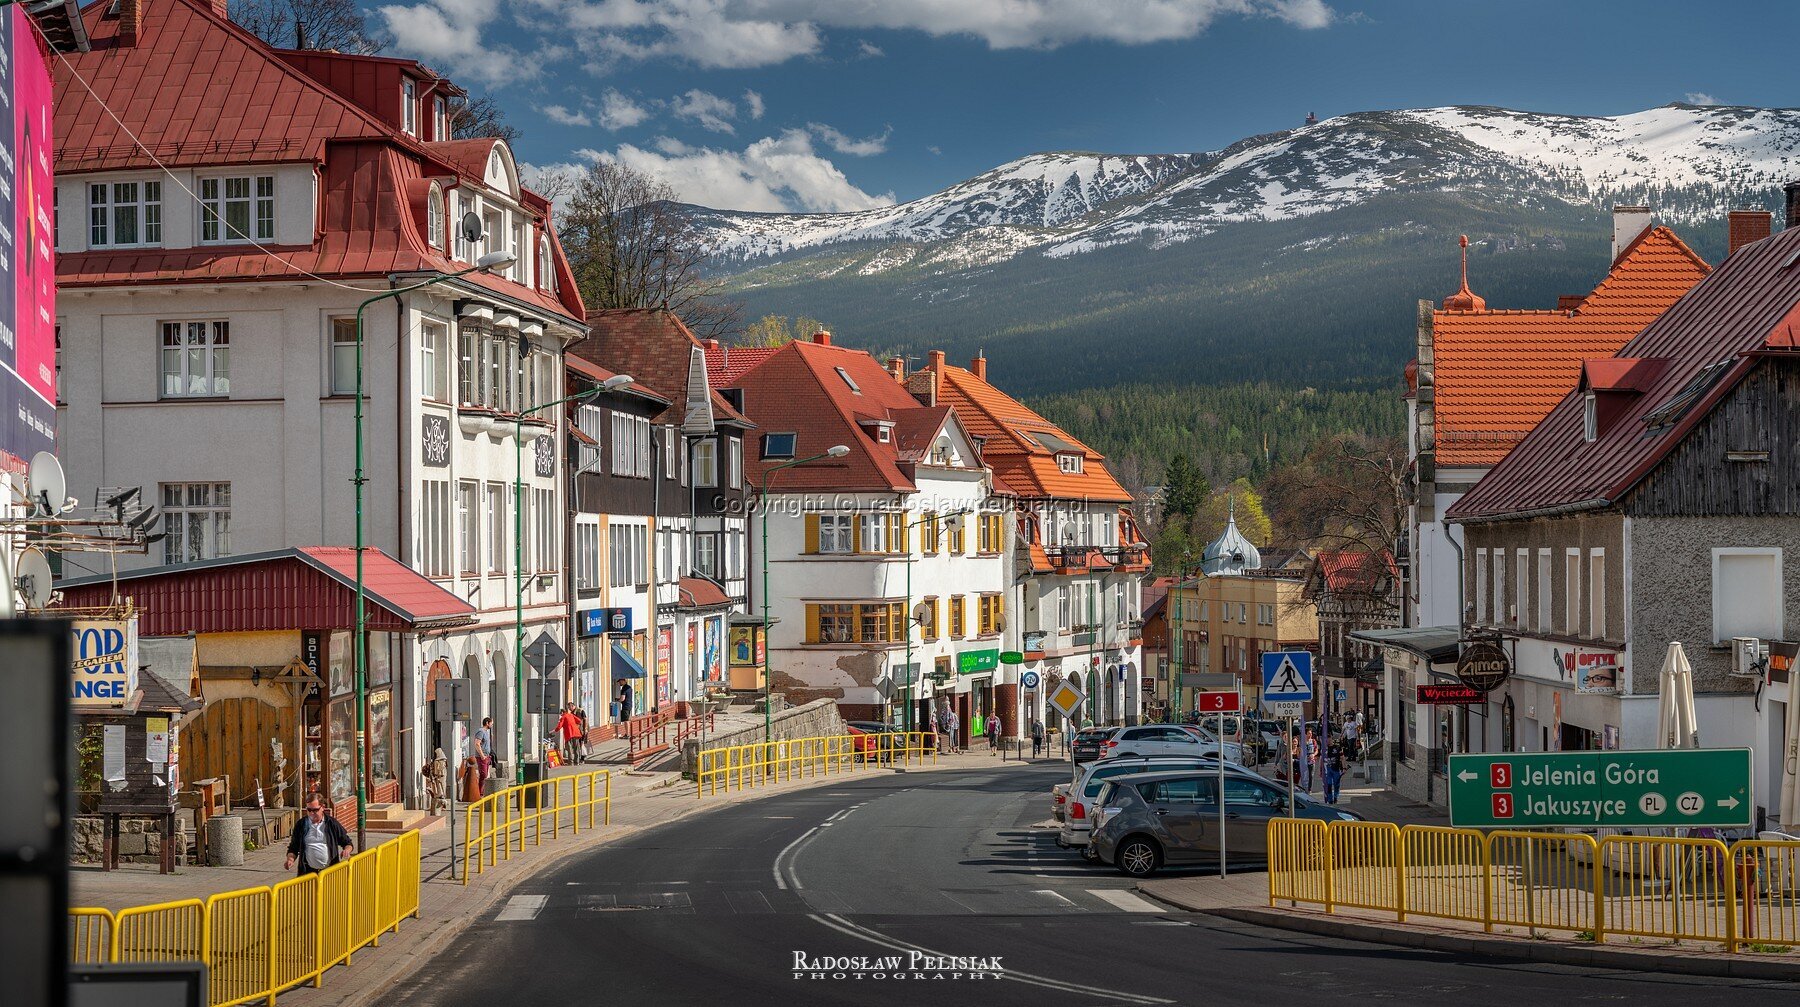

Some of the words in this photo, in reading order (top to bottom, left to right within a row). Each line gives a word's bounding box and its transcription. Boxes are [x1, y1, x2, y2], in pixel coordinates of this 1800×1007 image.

[72, 628, 124, 675] OR
[1579, 653, 1616, 667] OPTYK
[72, 680, 126, 698] NGE
[1215, 695, 1224, 709] 3
[1495, 767, 1506, 785] 3
[1521, 763, 1596, 786] Jelenia
[1605, 762, 1660, 785] Góra
[1497, 796, 1508, 814] 3
[1523, 794, 1627, 821] Jakuszyce
[1645, 798, 1661, 812] PL
[1680, 797, 1699, 812] CZ
